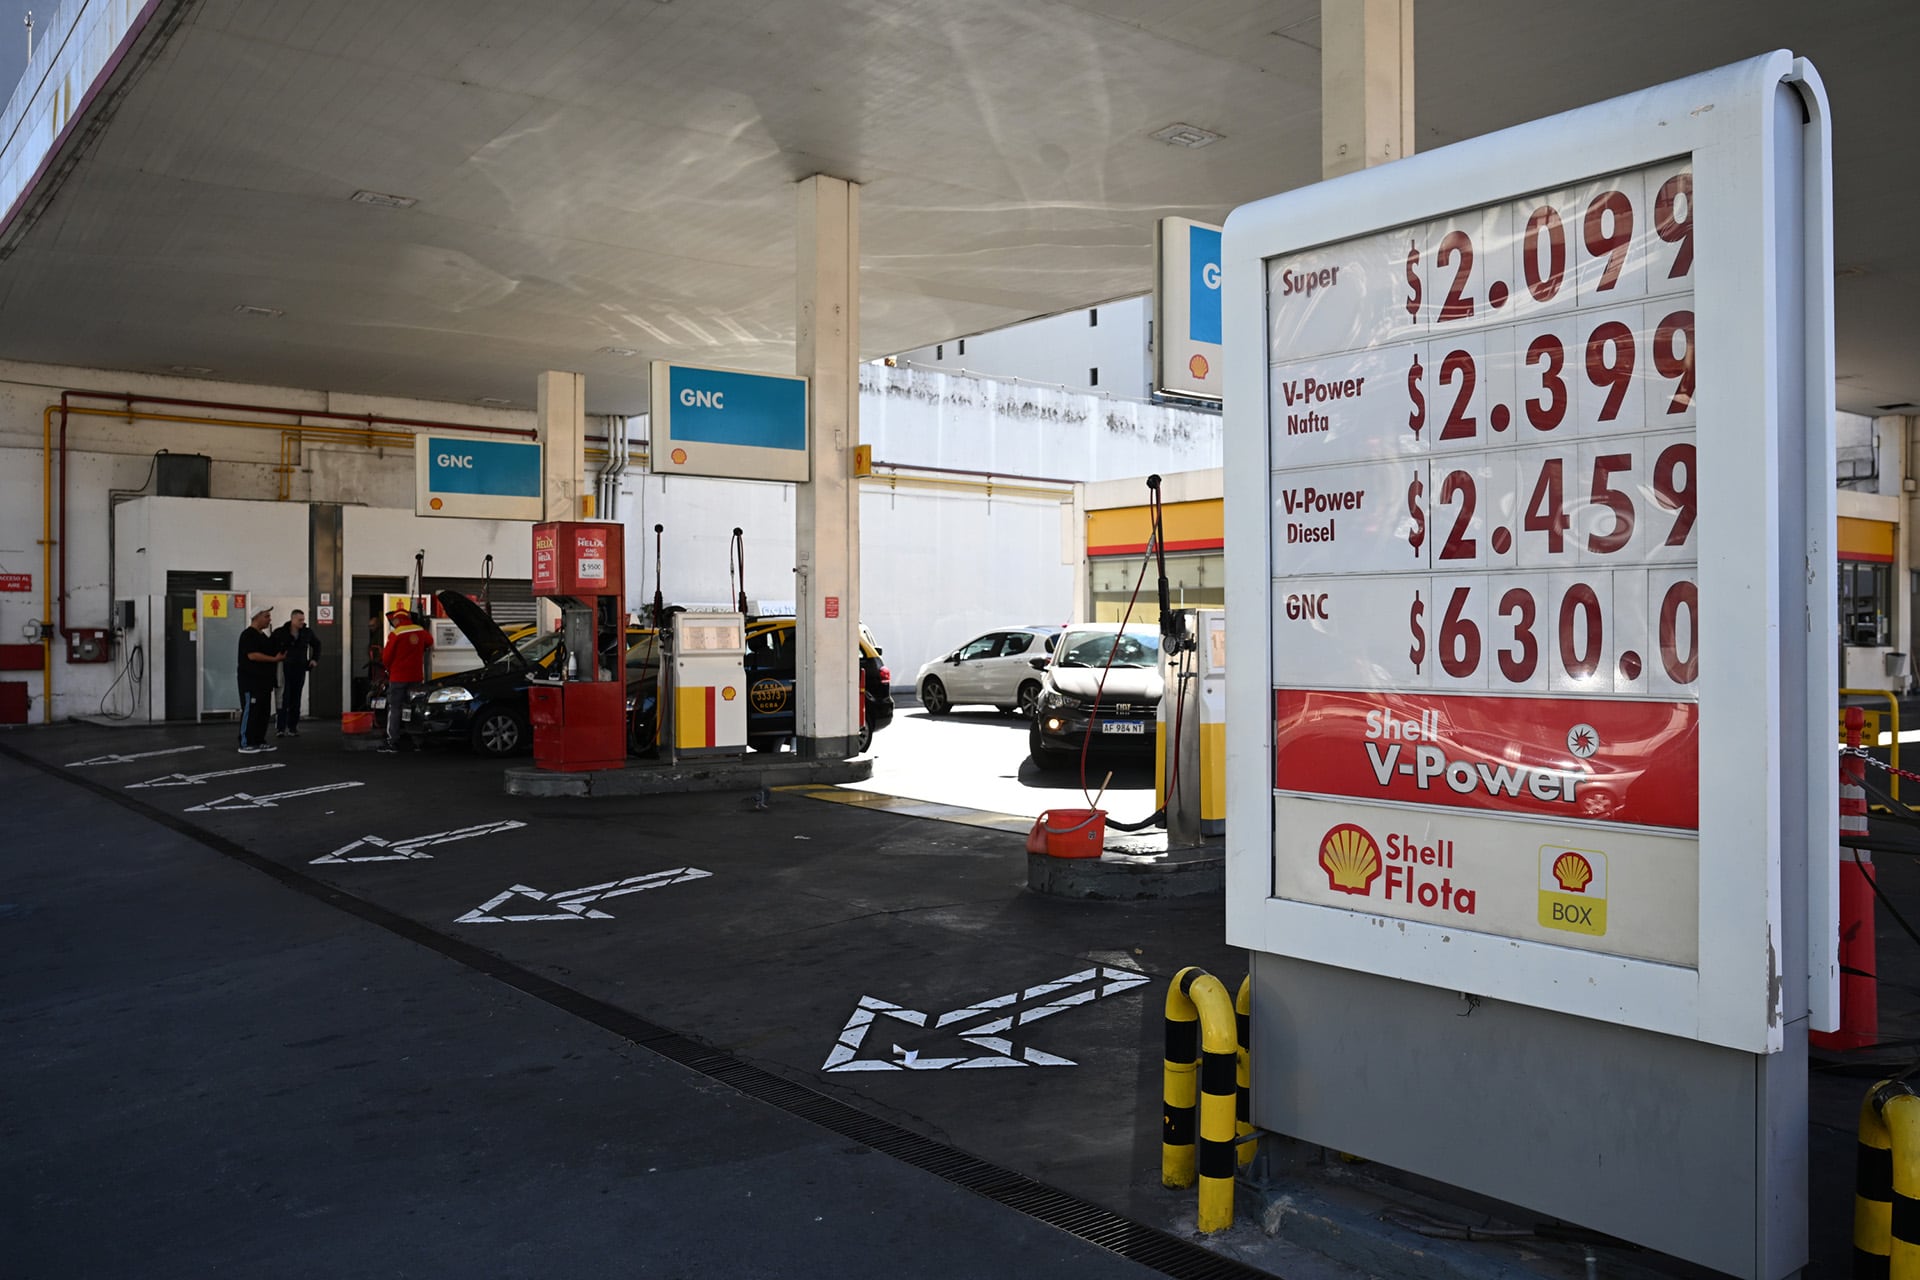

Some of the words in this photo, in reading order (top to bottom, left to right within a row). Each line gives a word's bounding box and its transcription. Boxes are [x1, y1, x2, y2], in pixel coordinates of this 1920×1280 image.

[1283, 264, 1339, 298] Super
[680, 388, 724, 410] GNC
[1283, 374, 1364, 407] V-Power
[1287, 412, 1329, 435] Nafta
[437, 454, 473, 469] GNC
[1282, 487, 1364, 514] V-Power
[1287, 519, 1335, 544] Diesel
[1286, 593, 1328, 620] GNC
[1366, 709, 1438, 742] Shell
[1364, 741, 1587, 802] V-Power
[1385, 833, 1453, 869] Shell
[1384, 865, 1476, 915] Flota
[1552, 902, 1593, 926] BOX
